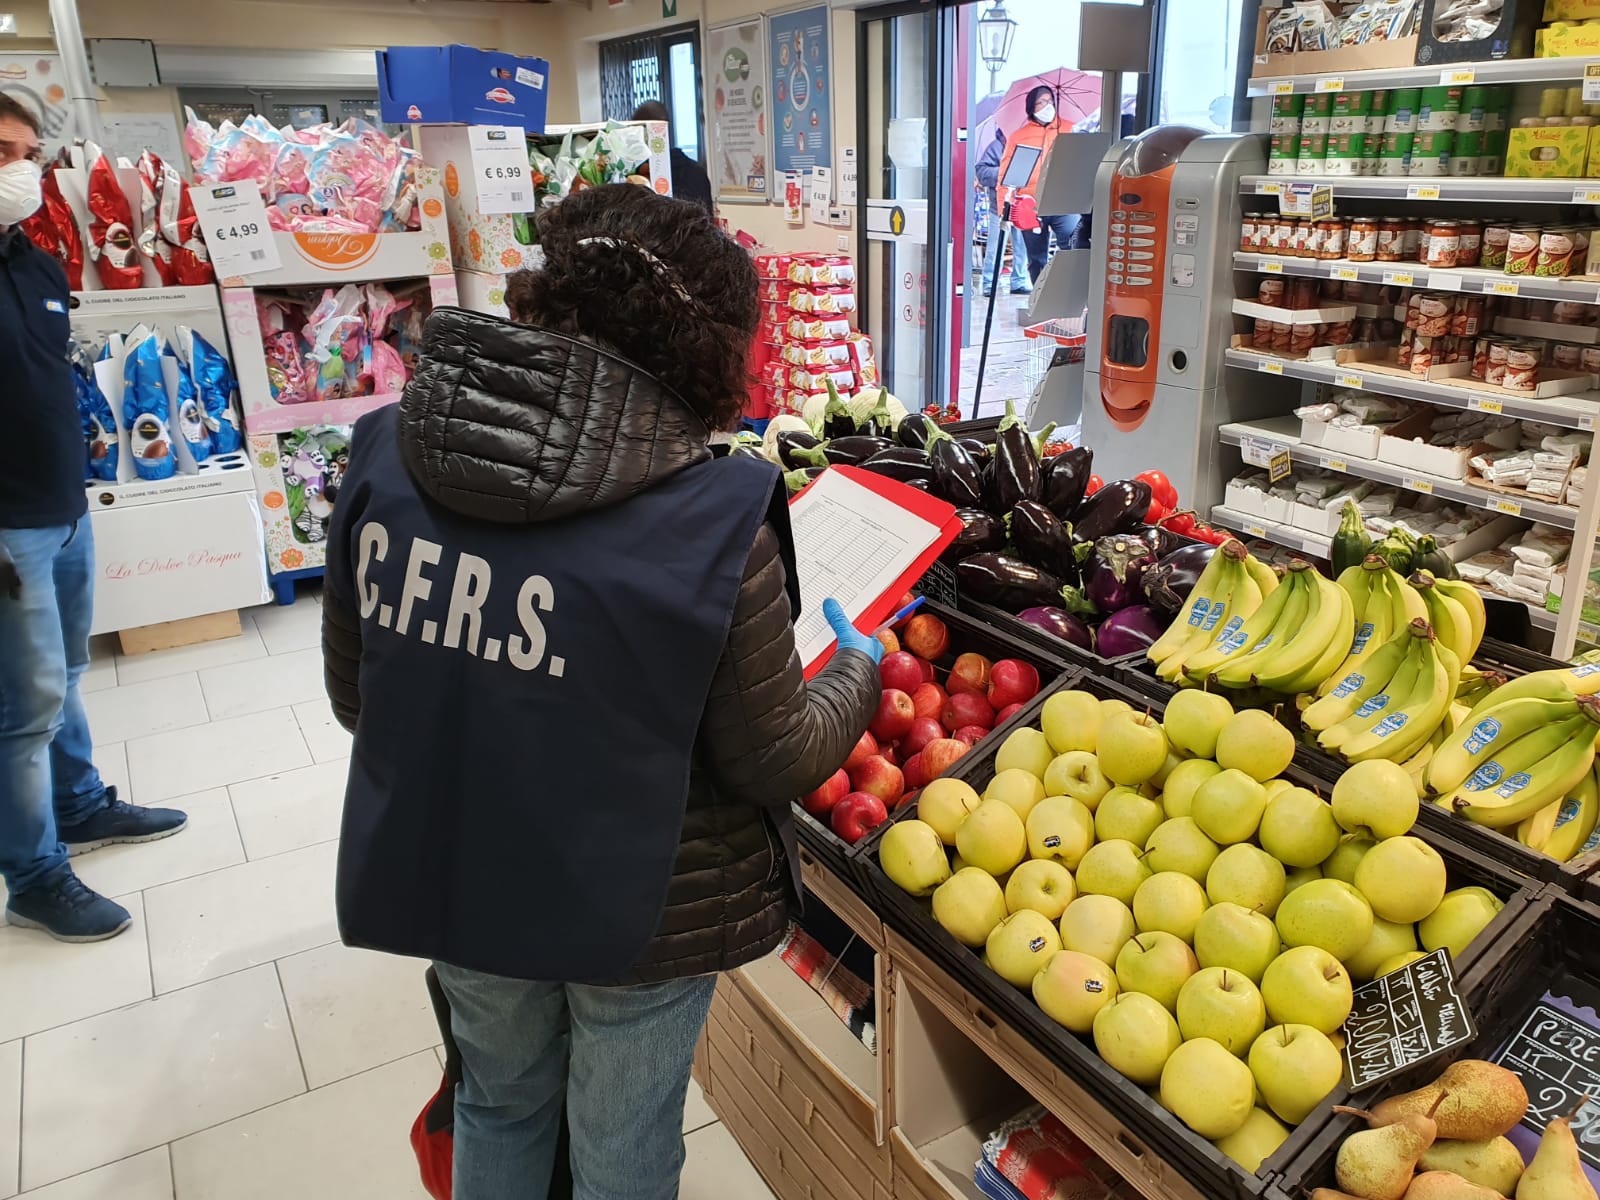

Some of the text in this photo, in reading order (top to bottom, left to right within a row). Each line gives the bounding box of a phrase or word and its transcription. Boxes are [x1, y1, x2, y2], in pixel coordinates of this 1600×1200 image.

[485, 166, 521, 180] € 6,99
[216, 222, 258, 240] € 4,99
[137, 558, 184, 576] Dolce
[187, 549, 242, 568] Pasqua
[357, 521, 565, 677] C.F.R.S.
